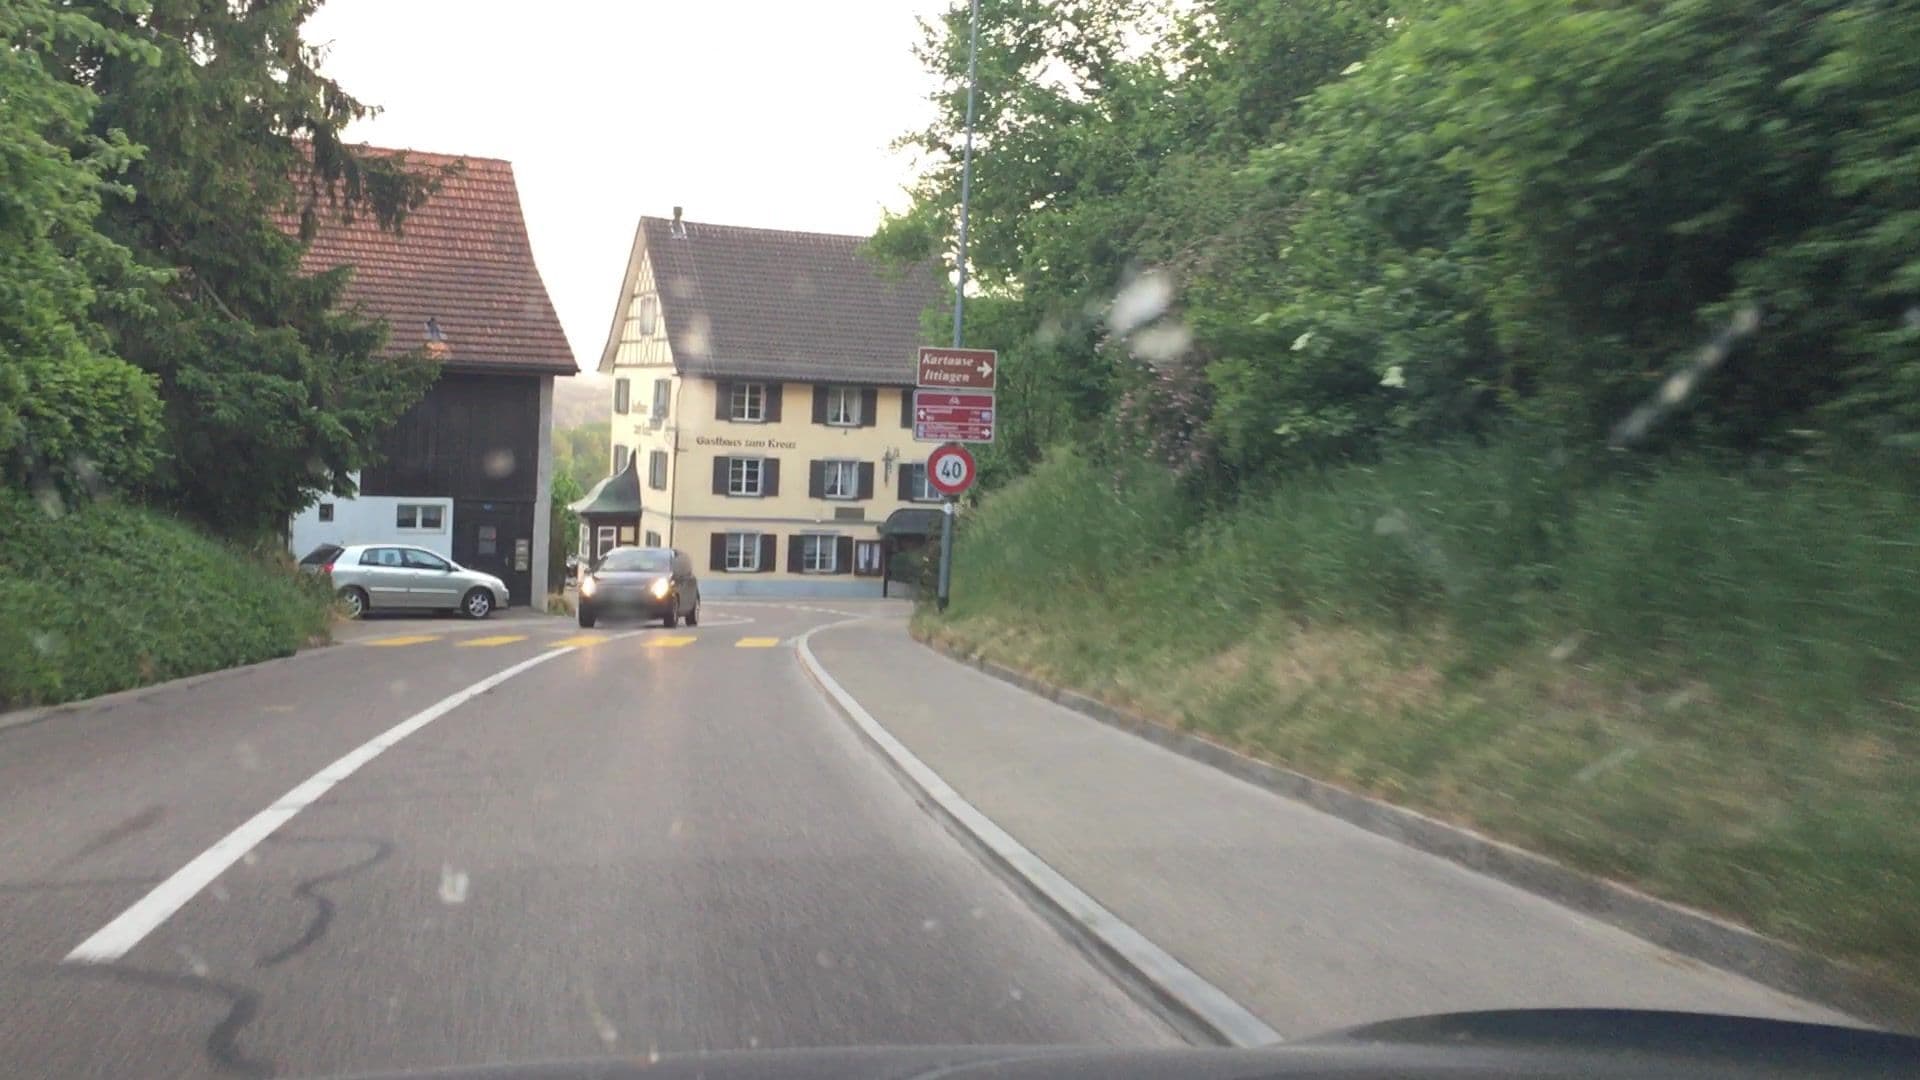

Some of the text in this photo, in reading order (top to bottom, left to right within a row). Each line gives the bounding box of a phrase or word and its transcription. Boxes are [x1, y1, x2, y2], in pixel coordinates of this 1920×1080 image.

[922, 352, 974, 366] Kartause
[925, 369, 970, 384] Ittingen
[696, 436, 742, 447] Gasthaus
[941, 460, 962, 479] 40
